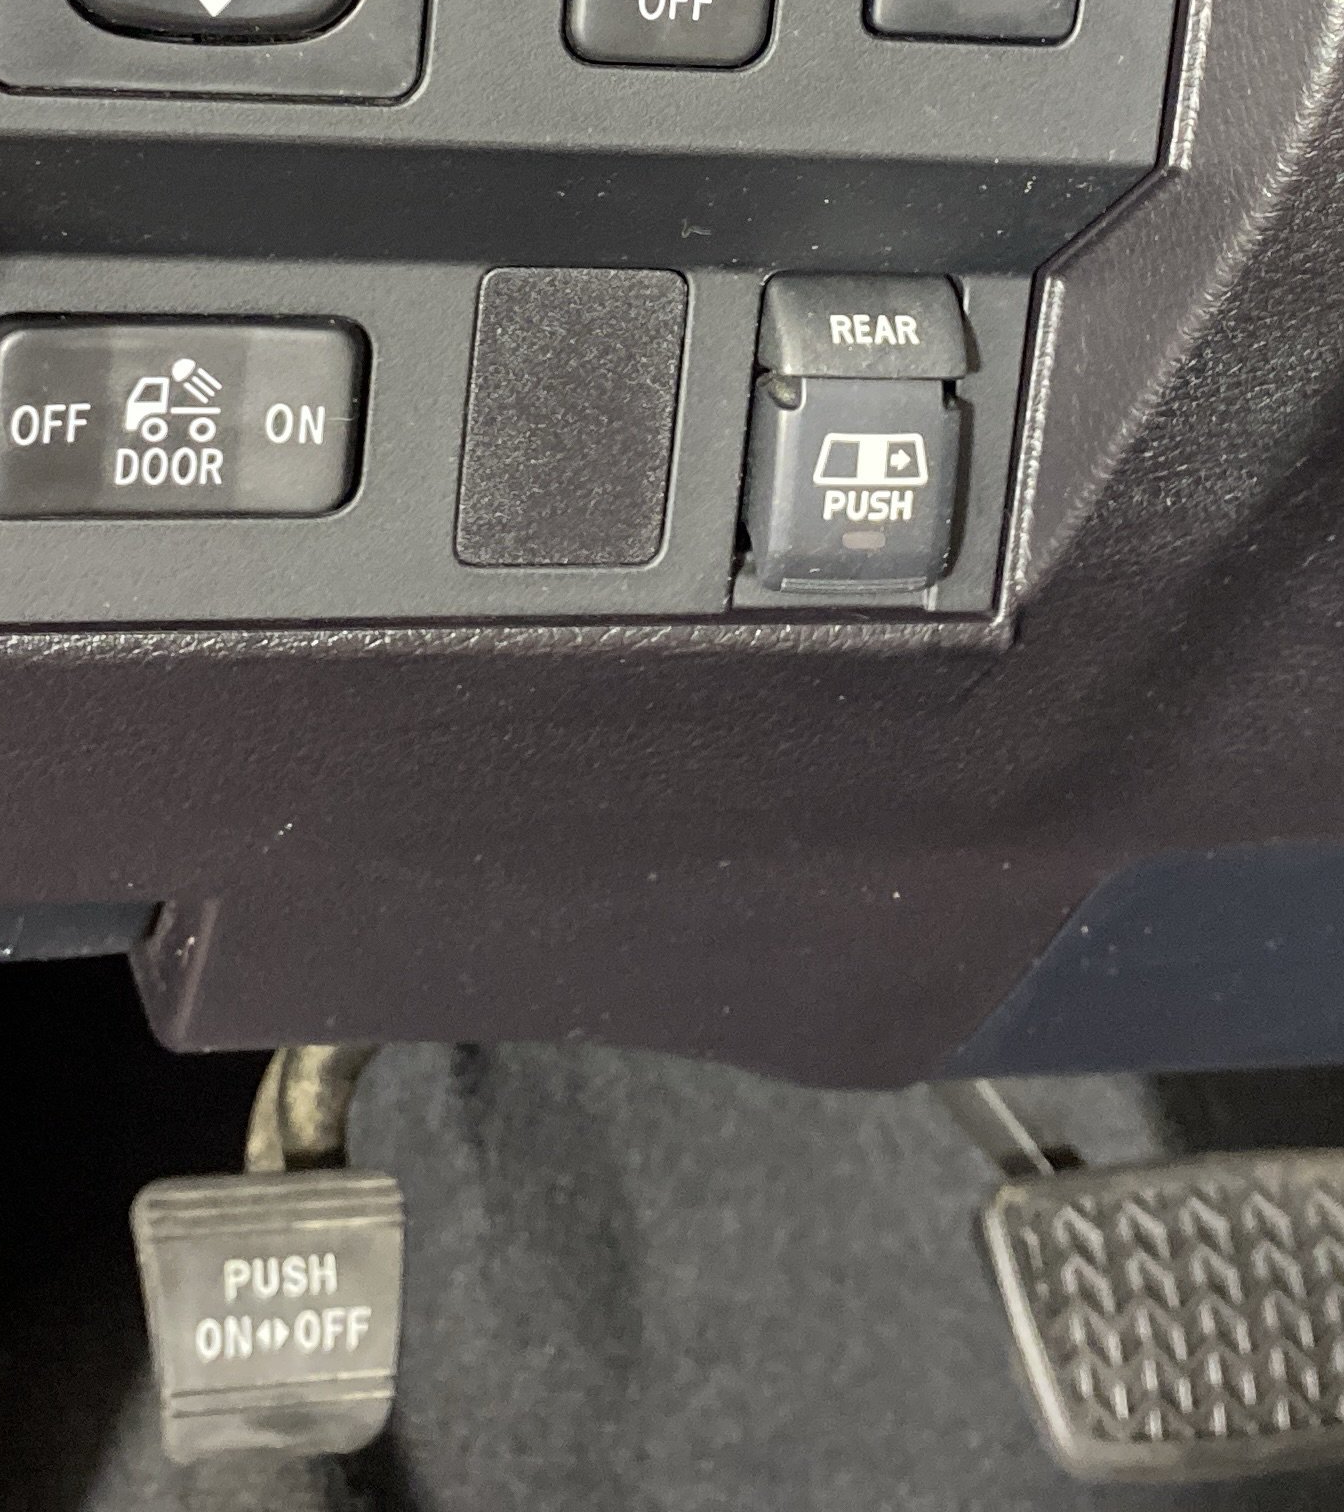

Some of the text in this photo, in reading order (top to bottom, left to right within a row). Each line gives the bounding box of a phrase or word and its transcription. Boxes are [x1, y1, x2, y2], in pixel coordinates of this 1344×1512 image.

[829, 314, 920, 345] REAR
[10, 403, 92, 446] OFF
[264, 403, 326, 444] ON
[114, 447, 224, 486] DOOR
[822, 490, 914, 521] PUSH
[223, 1252, 338, 1304] PUSH
